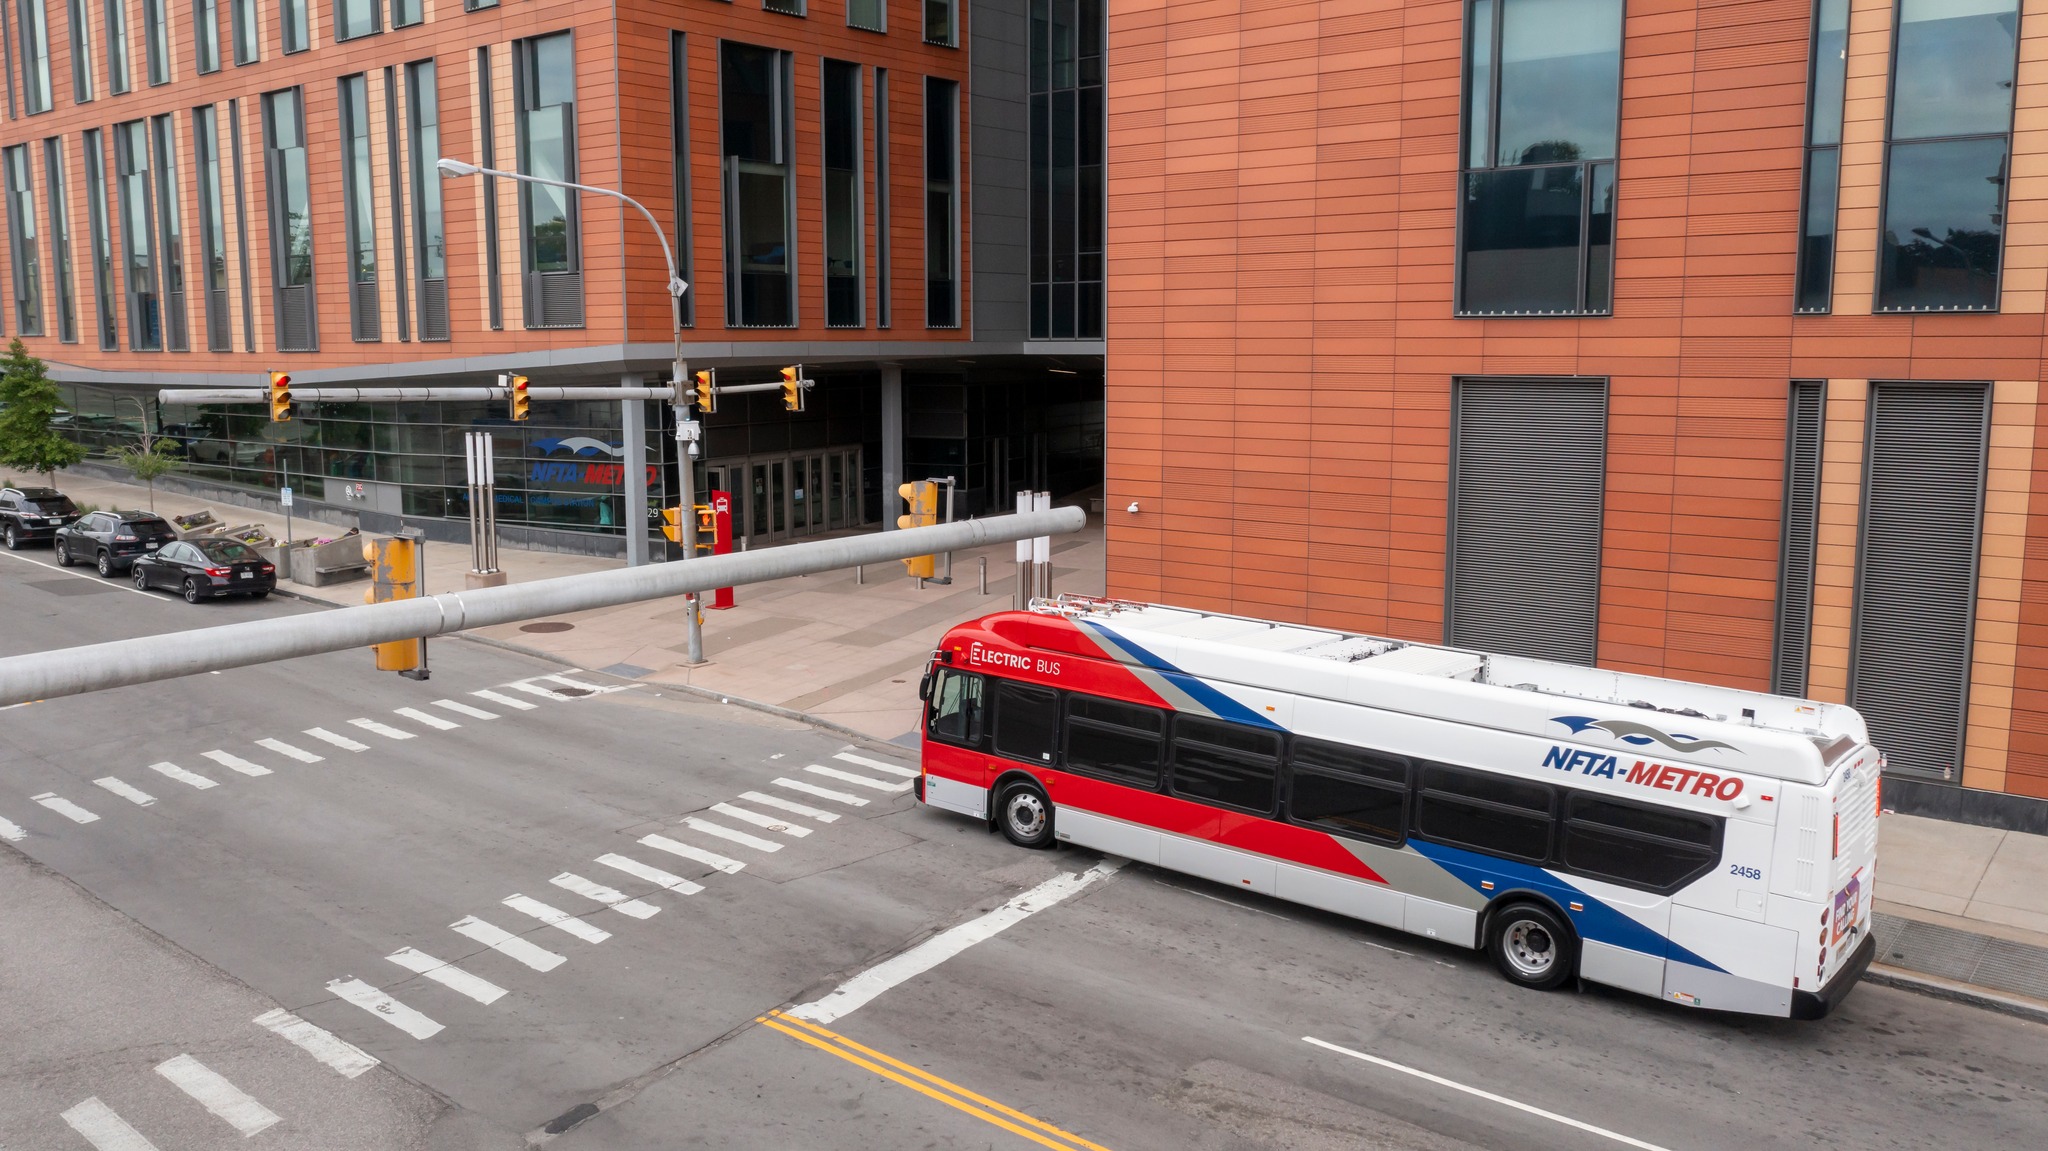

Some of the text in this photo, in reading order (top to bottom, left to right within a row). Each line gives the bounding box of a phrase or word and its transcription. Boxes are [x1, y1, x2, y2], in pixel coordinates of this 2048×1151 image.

[531, 462, 657, 487] NFTA-METO
[970, 642, 1061, 676] ELECTRIC BUS
[1541, 745, 1744, 802] NFTA-METRO
[1730, 864, 1761, 881] 2458
